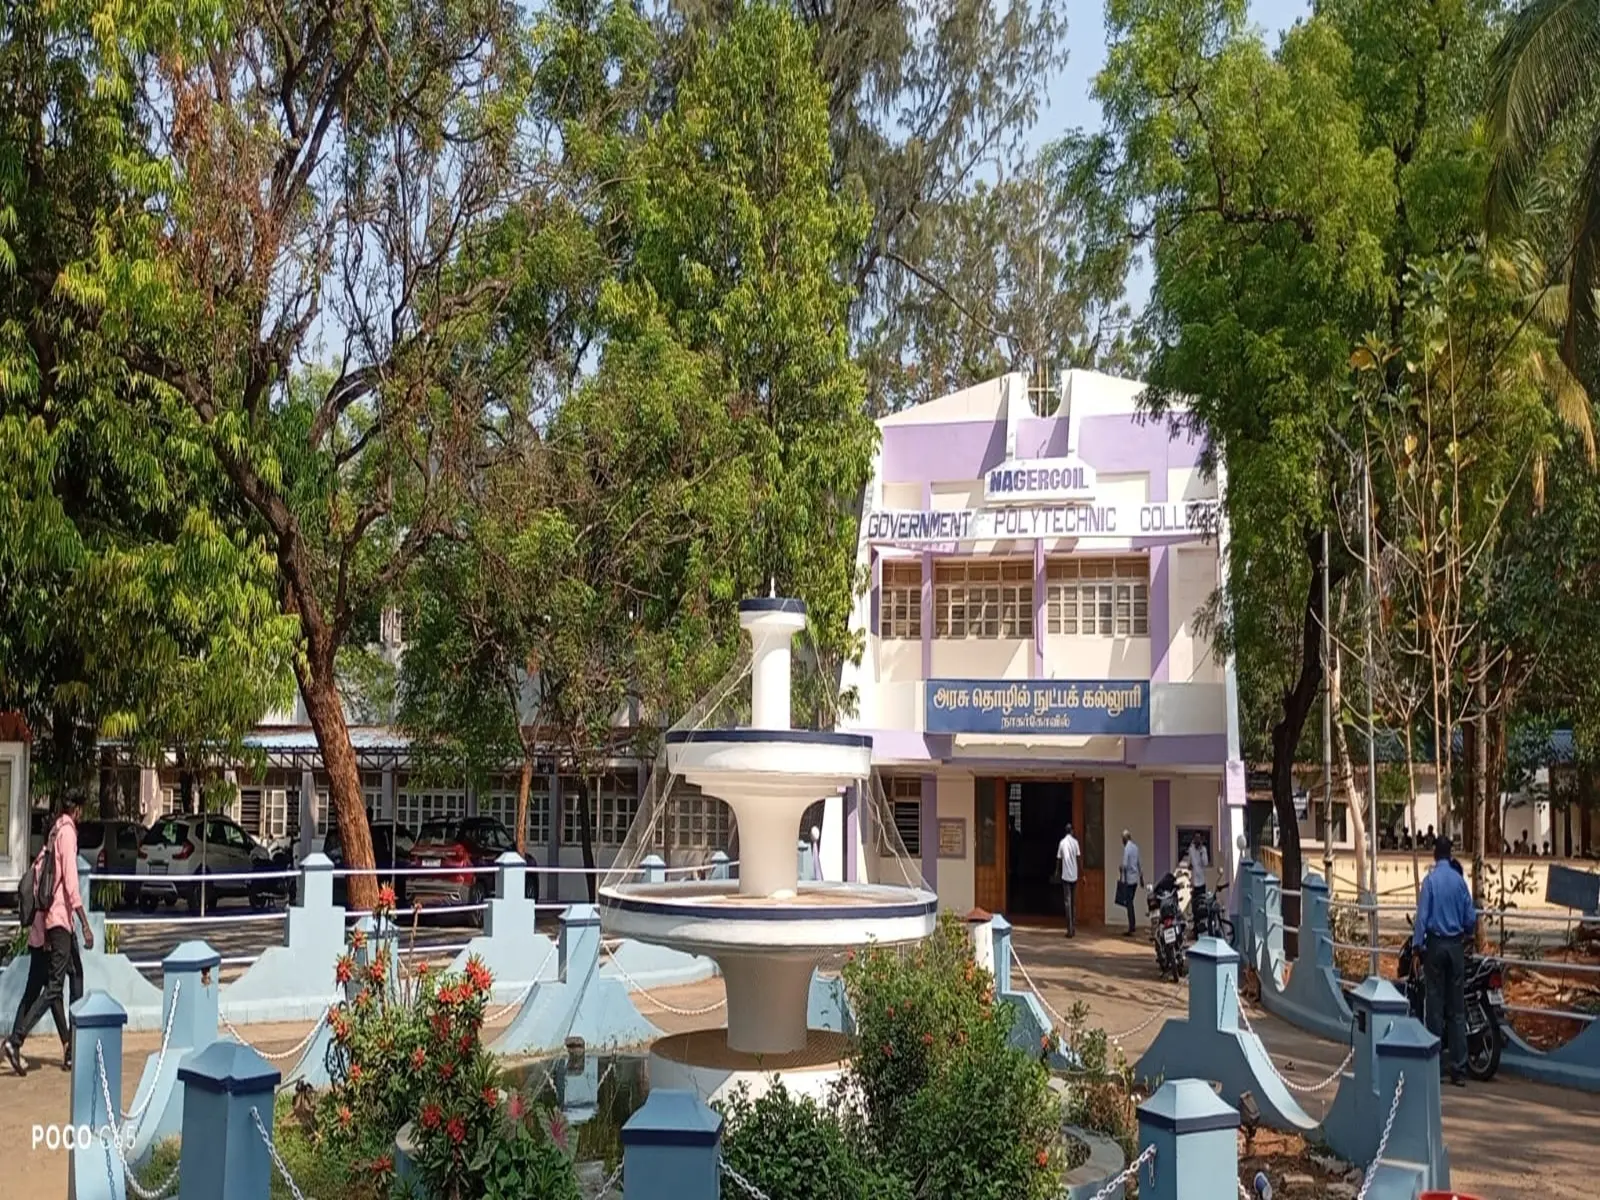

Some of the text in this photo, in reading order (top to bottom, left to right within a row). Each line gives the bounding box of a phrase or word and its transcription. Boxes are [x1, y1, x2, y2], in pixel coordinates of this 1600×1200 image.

[989, 468, 1089, 493] NAGERCOIL
[868, 503, 1218, 537] GOVERNMENT POLYTECHNIC COLLE
[934, 683, 1141, 717] அரசு தொழில் நுட்பக் கல்லூரி
